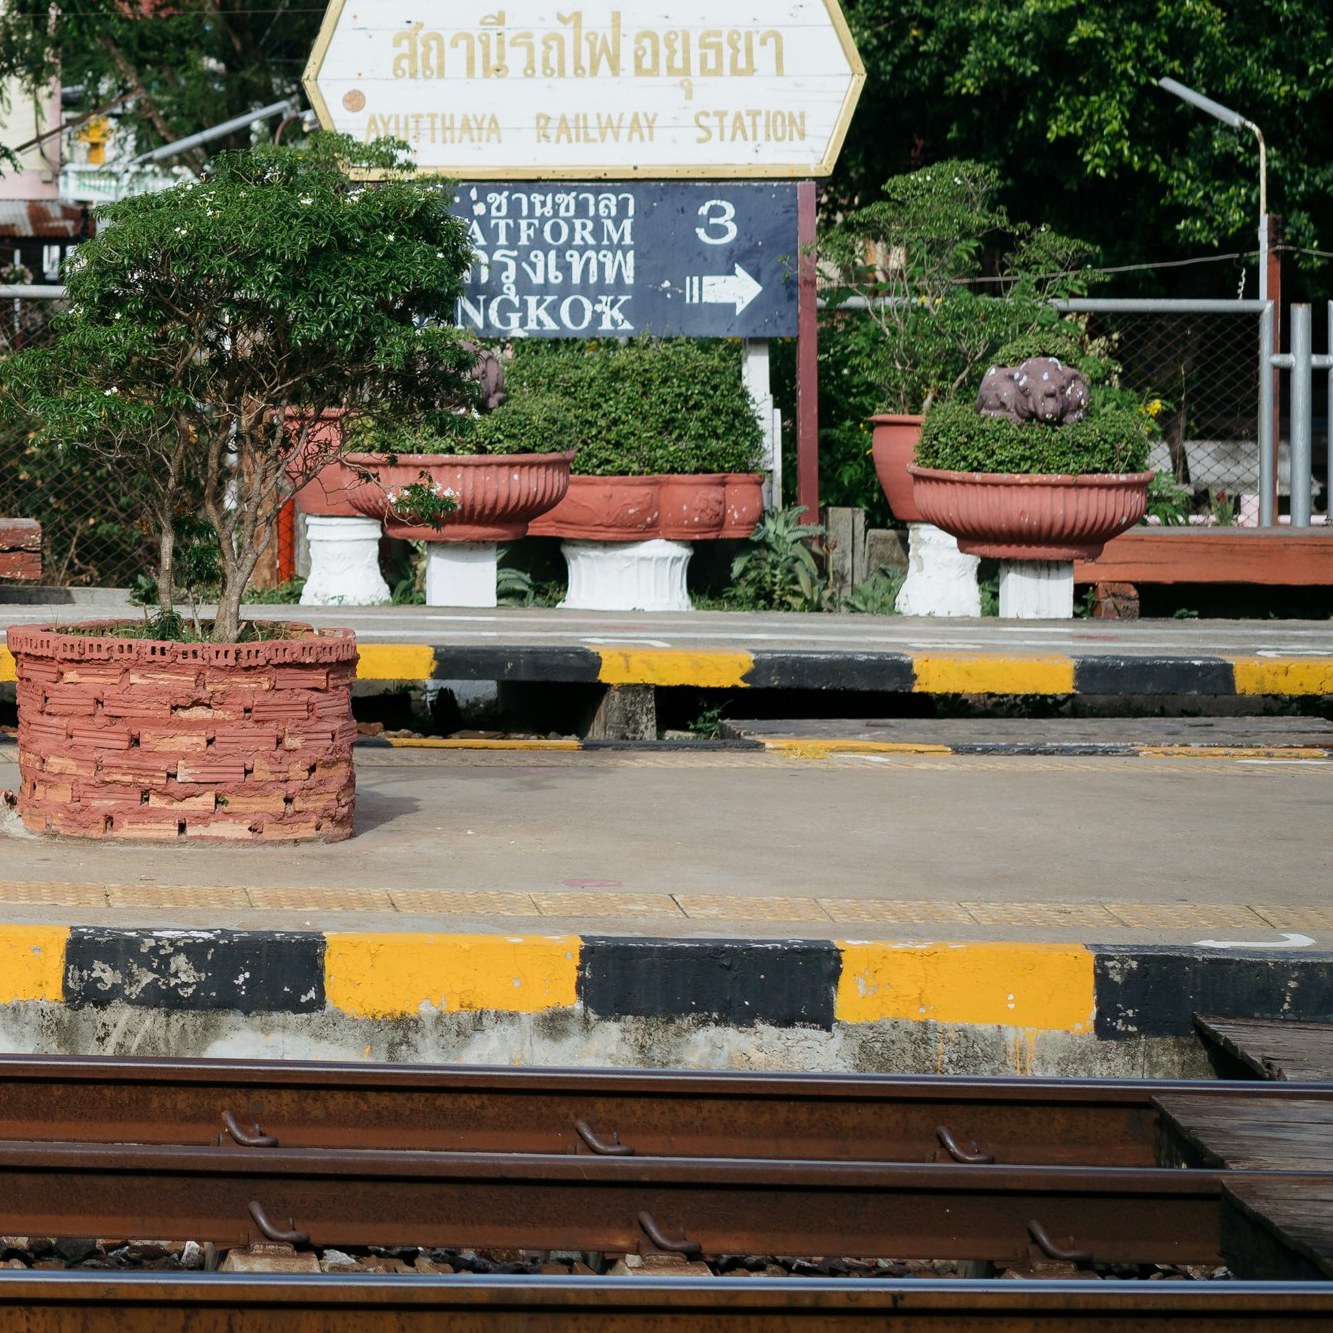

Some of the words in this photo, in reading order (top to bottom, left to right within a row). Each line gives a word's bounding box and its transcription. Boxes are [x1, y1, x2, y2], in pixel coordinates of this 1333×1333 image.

[365, 113, 502, 144] AYUTTHAYA
[535, 112, 659, 144] RAILWAY
[693, 109, 806, 144] STATION
[468, 218, 634, 245] ATFORM
[695, 199, 738, 245] 3
[454, 295, 634, 330] NGKOK
